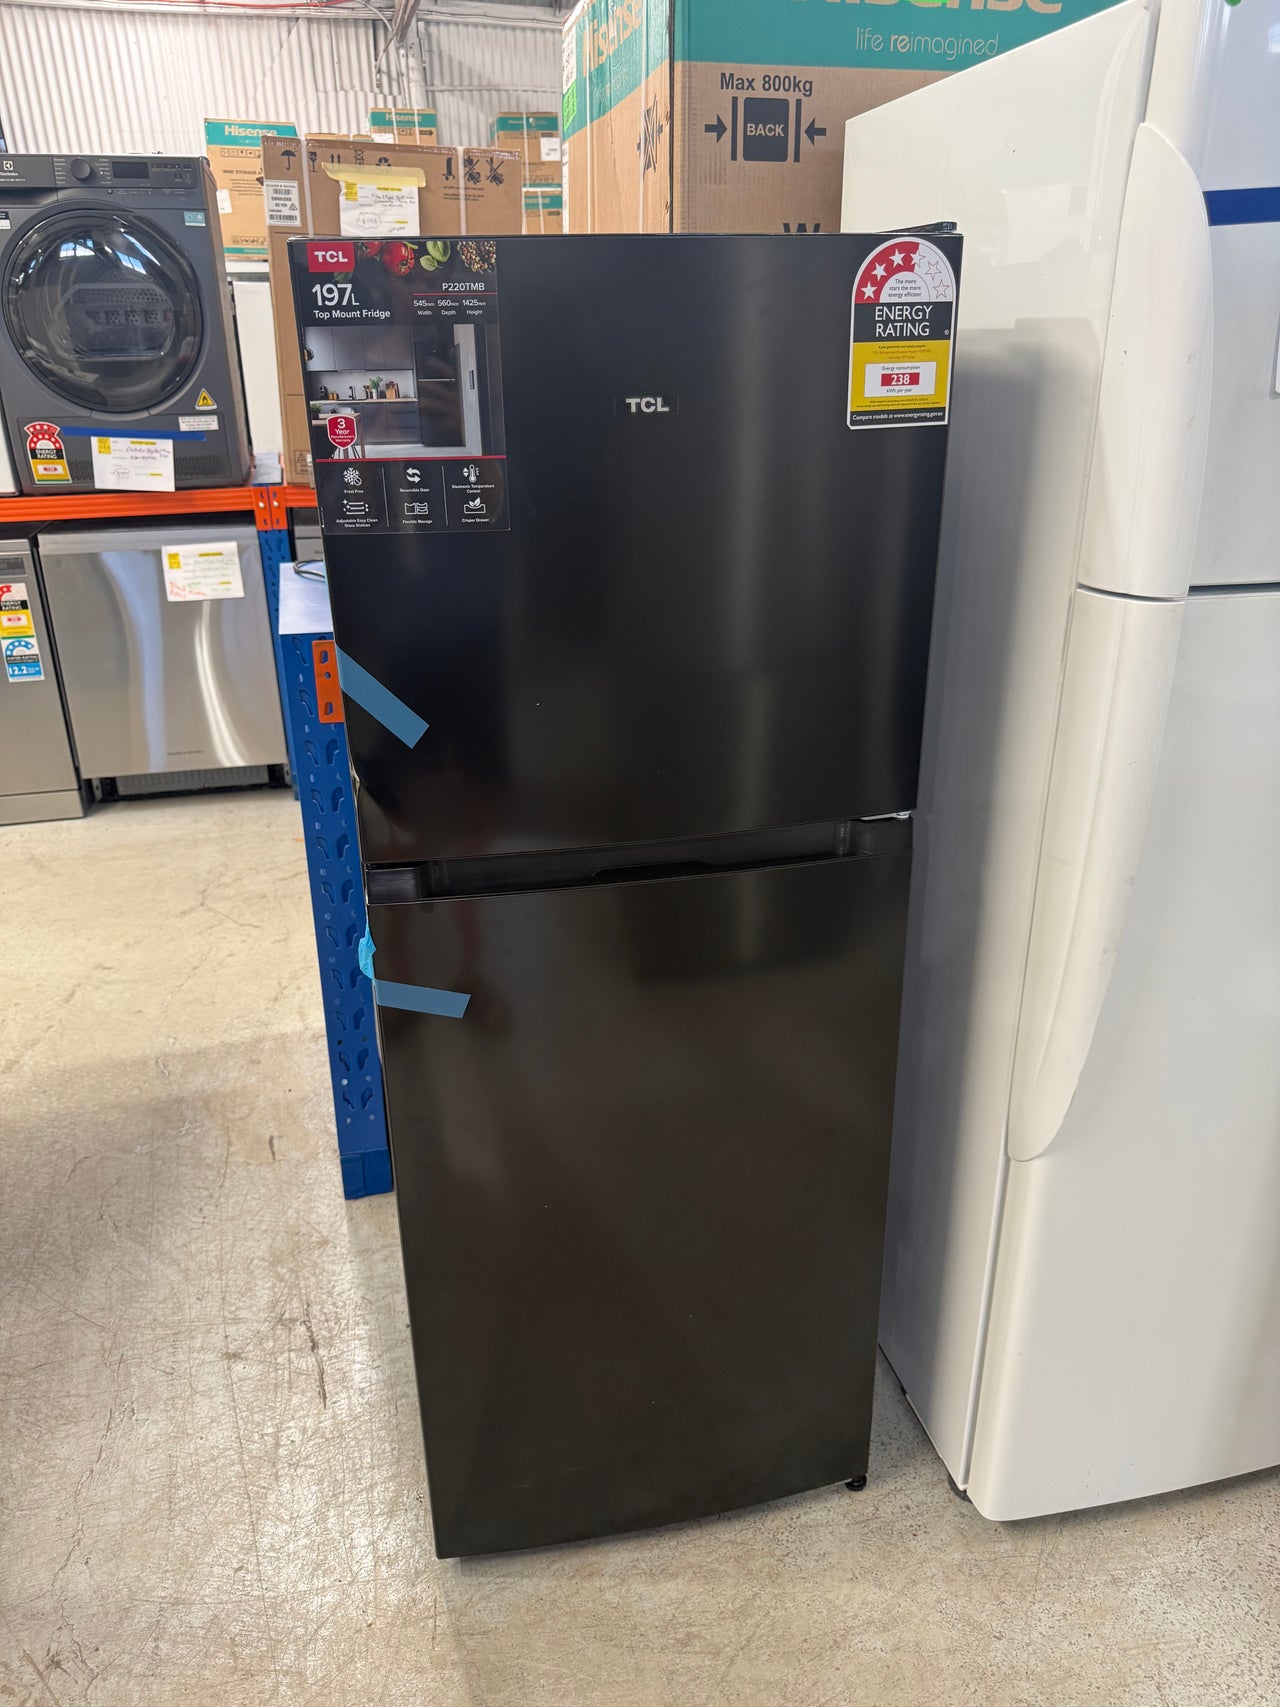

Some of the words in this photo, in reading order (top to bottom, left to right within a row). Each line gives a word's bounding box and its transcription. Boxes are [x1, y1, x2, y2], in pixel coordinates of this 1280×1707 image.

[856, 27, 884, 50] life
[890, 31, 999, 60] reimagined
[720, 72, 756, 91] Max
[762, 74, 813, 97] 800kg
[224, 125, 278, 137] Hisense
[746, 123, 785, 136] BACK
[314, 250, 348, 263] TCL
[442, 282, 485, 291] P220TMB
[311, 283, 360, 307] 197L
[413, 299, 434, 307] 545mm
[437, 299, 459, 307] 560mm
[462, 299, 486, 307] 1425mm
[313, 310, 330, 320] Top
[332, 310, 360, 318] Mount
[362, 309, 391, 319] Fridge
[875, 305, 933, 321] ENERGY
[876, 322, 930, 338] RATING
[891, 374, 910, 385] 238
[625, 397, 670, 413] TCL
[337, 418, 346, 429] 3
[9, 665, 28, 675] 12.2
